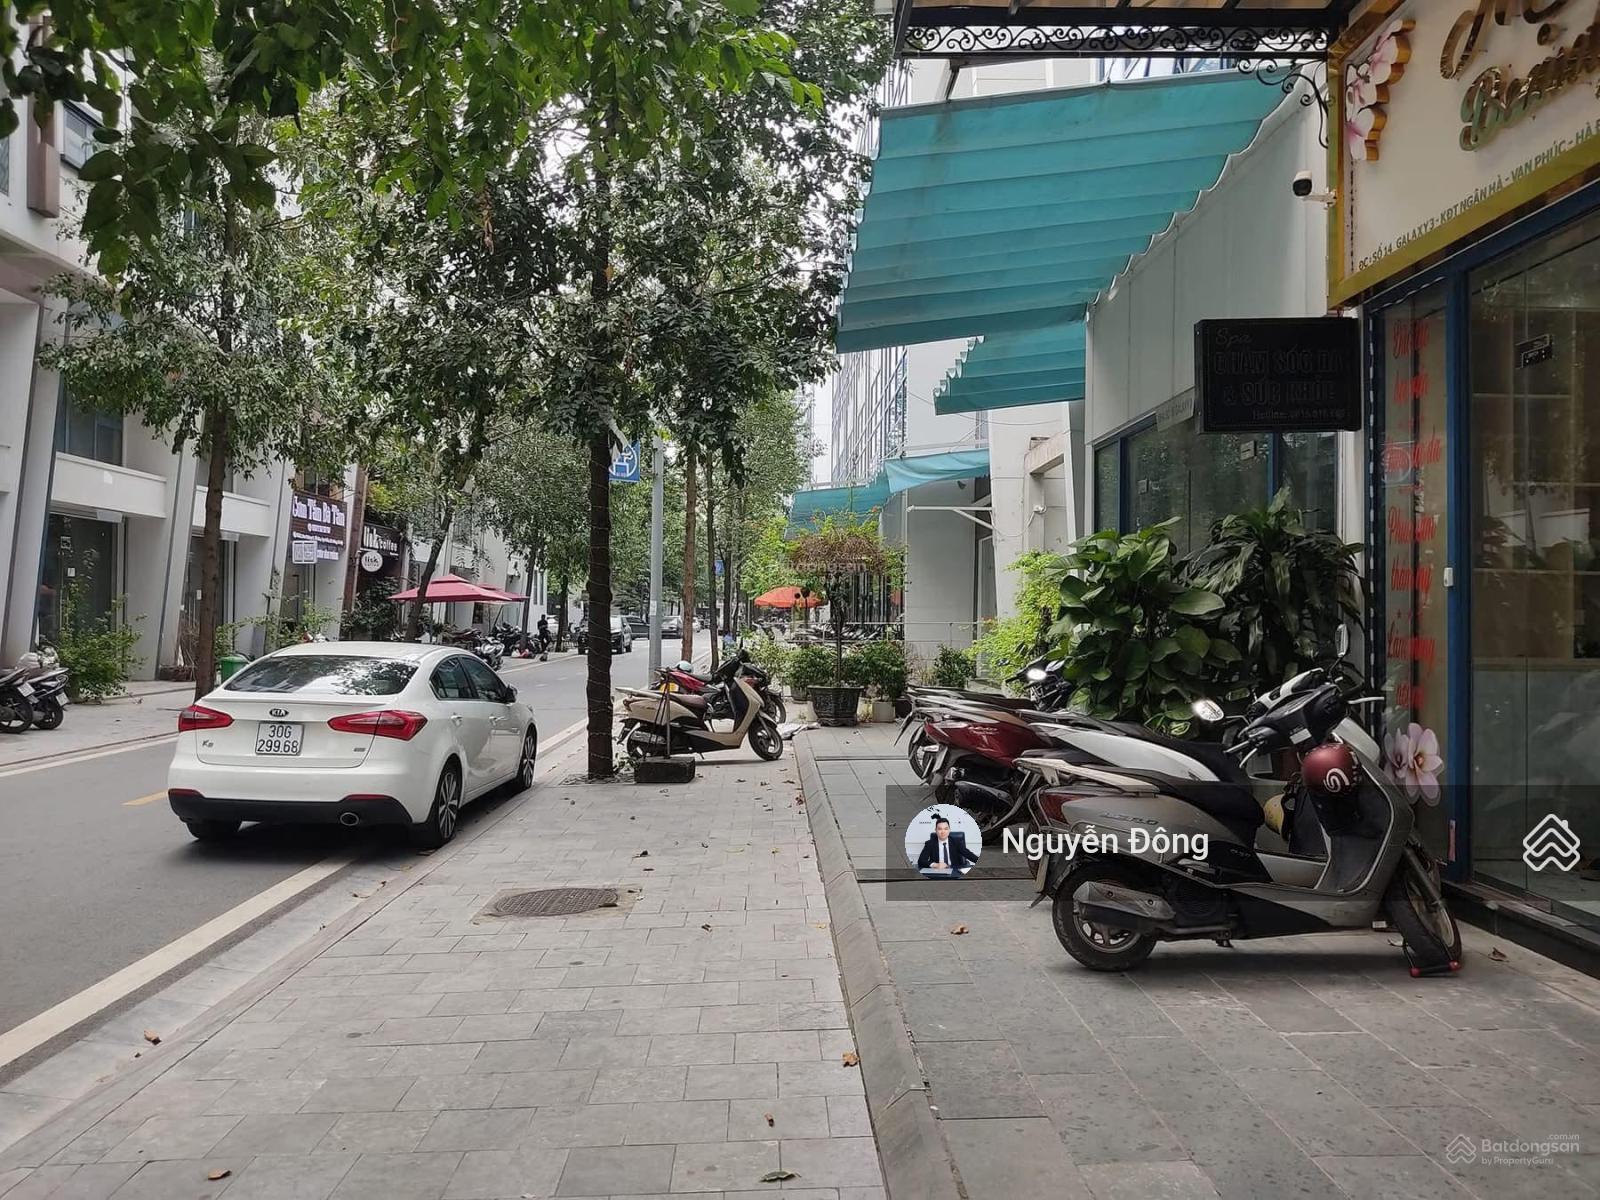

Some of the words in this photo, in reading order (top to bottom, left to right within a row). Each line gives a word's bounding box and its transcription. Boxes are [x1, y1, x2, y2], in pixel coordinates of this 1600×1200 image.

[270, 709, 287, 717] KIA
[268, 725, 292, 739] 30G
[257, 739, 299, 754] 299.68
